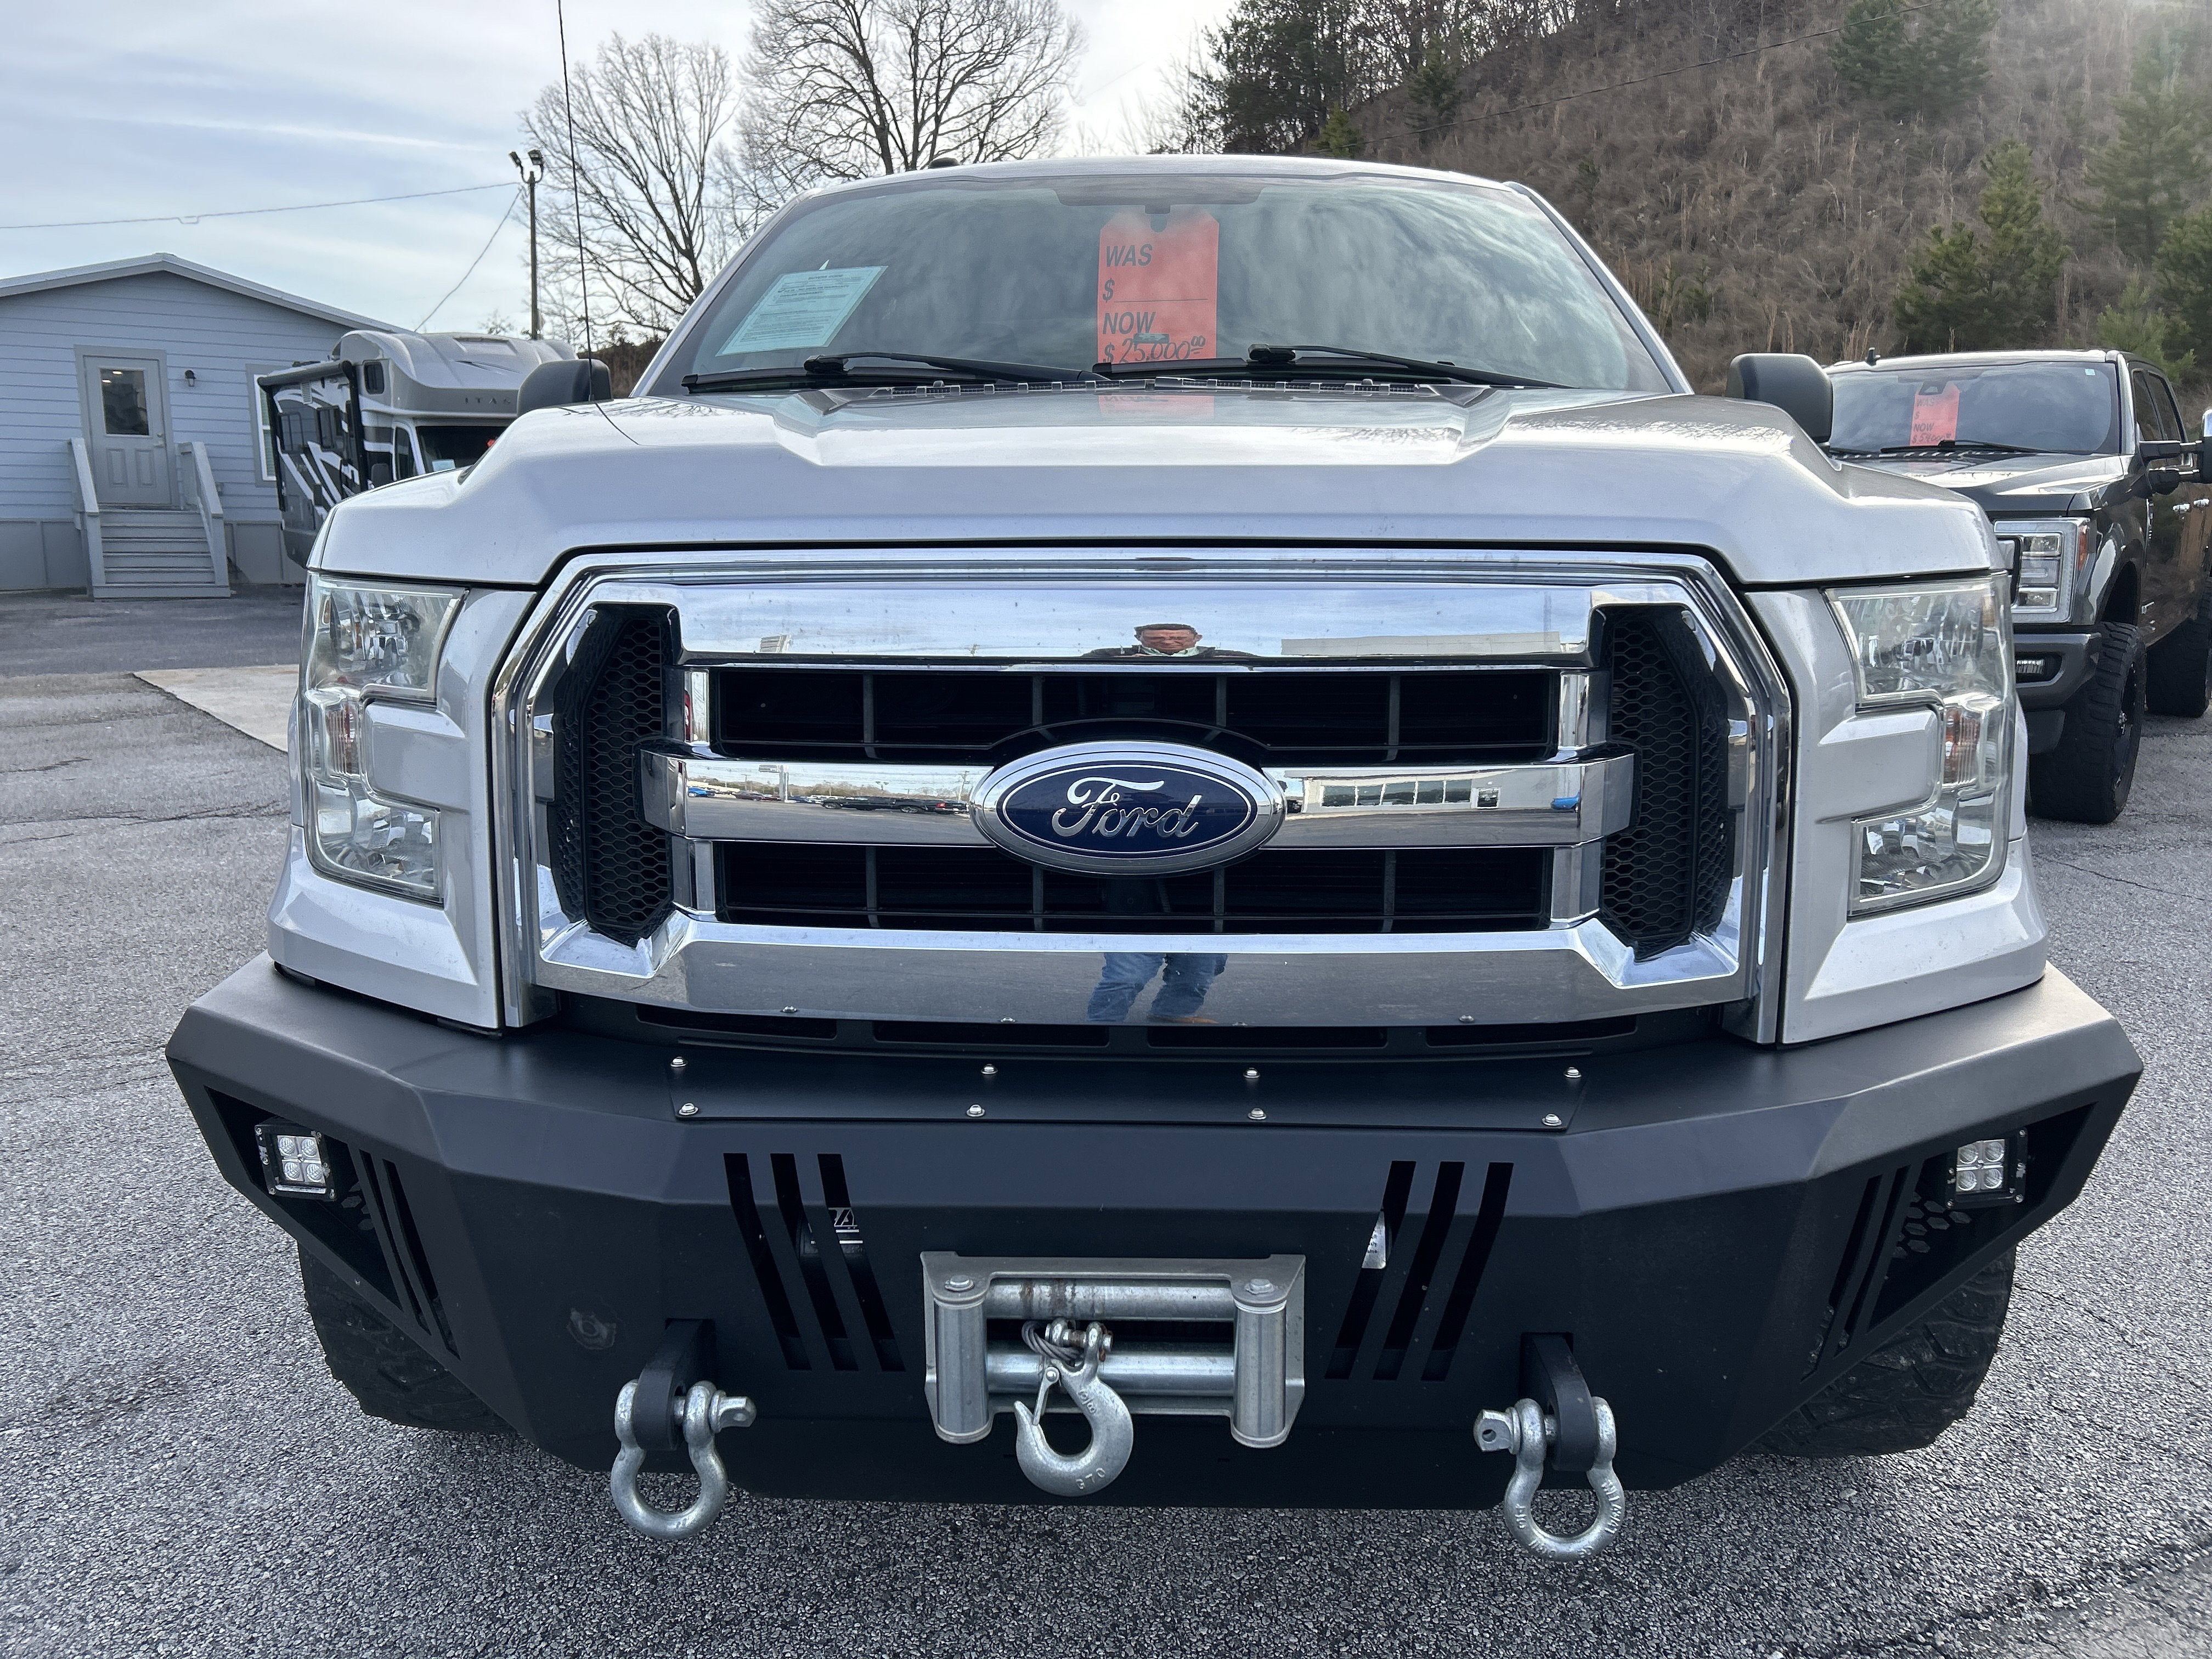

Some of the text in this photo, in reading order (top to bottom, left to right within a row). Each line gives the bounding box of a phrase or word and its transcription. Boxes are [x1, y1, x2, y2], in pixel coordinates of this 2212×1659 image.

[1106, 244, 1152, 267] WAS
[1103, 278, 1115, 302] $
[1103, 312, 1156, 334] NOW
[1914, 423, 1934, 432] NOW
[1052, 777, 1202, 837] Ford
